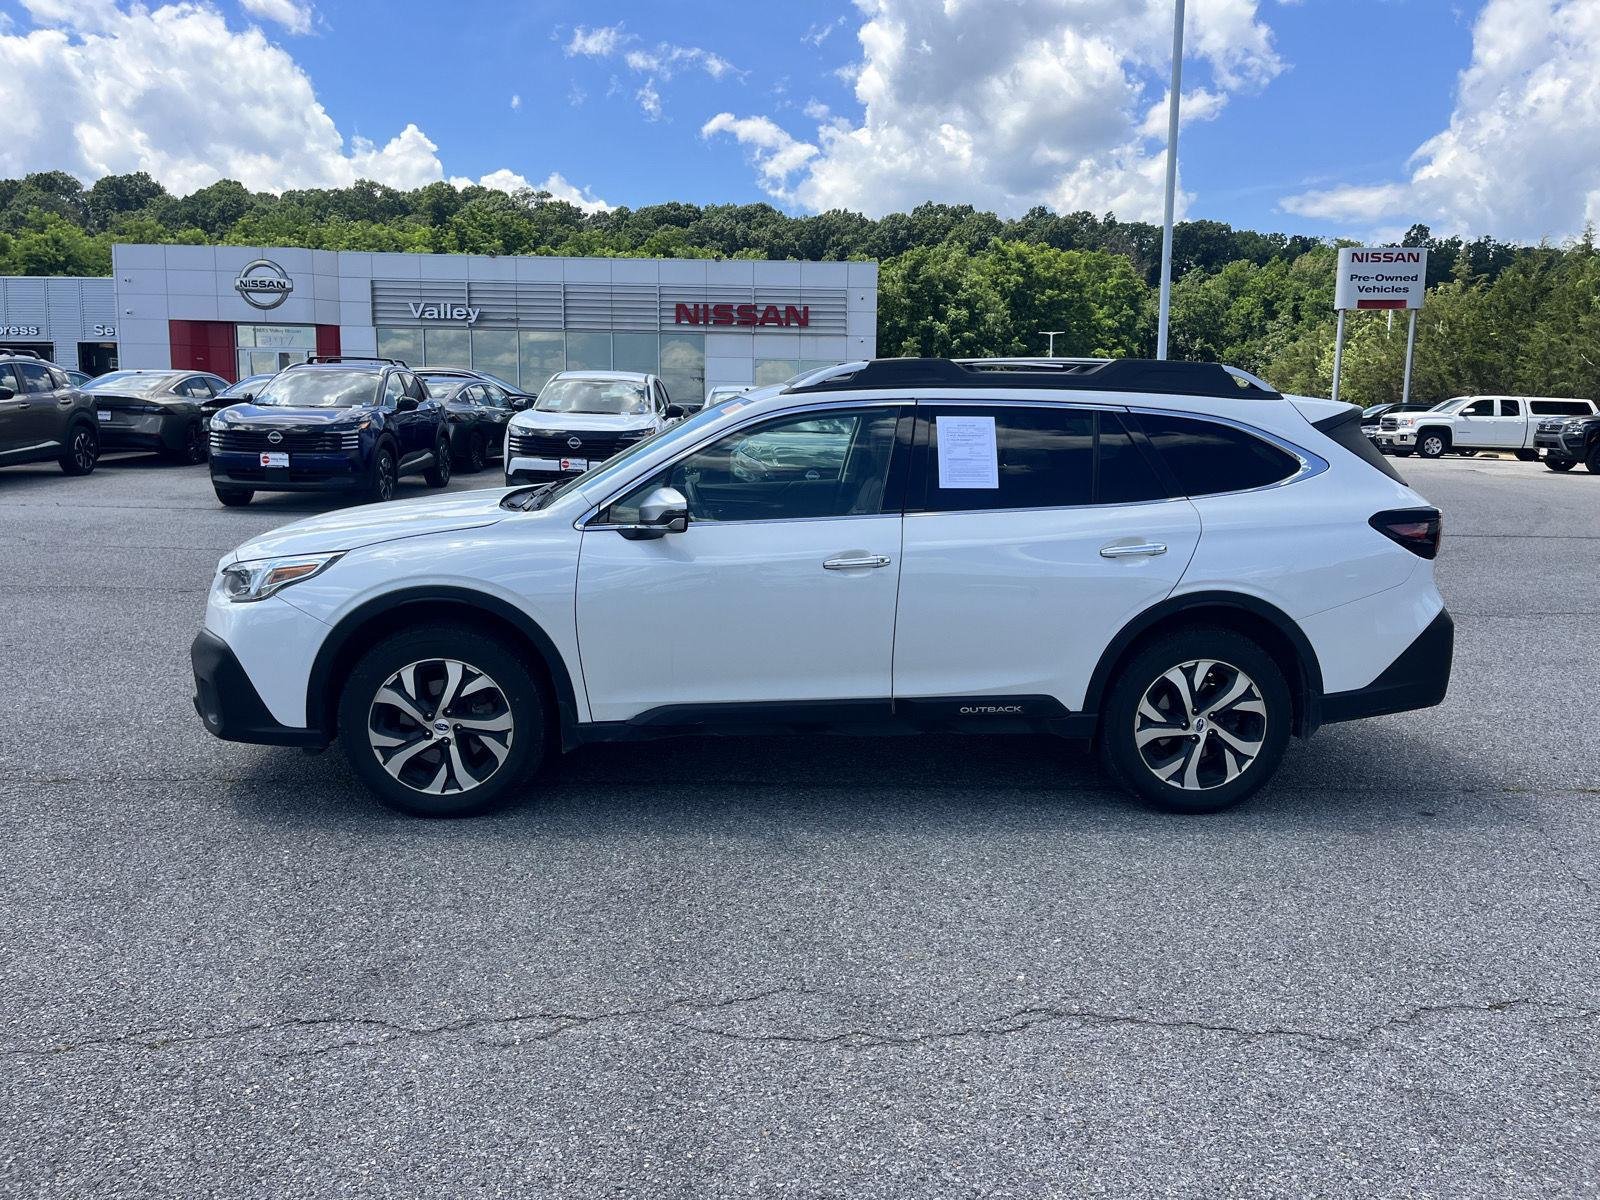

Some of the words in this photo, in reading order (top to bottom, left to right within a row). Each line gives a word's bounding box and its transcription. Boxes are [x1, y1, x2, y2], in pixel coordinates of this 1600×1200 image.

[1351, 252, 1420, 263] NISSAN
[1350, 273, 1419, 282] Pre-Owned
[239, 279, 286, 289] NISSAN
[1357, 285, 1410, 293] Vehicles
[408, 302, 480, 324] Valley
[675, 303, 809, 327] NISSAN
[959, 705, 1022, 714] OUTBACK
